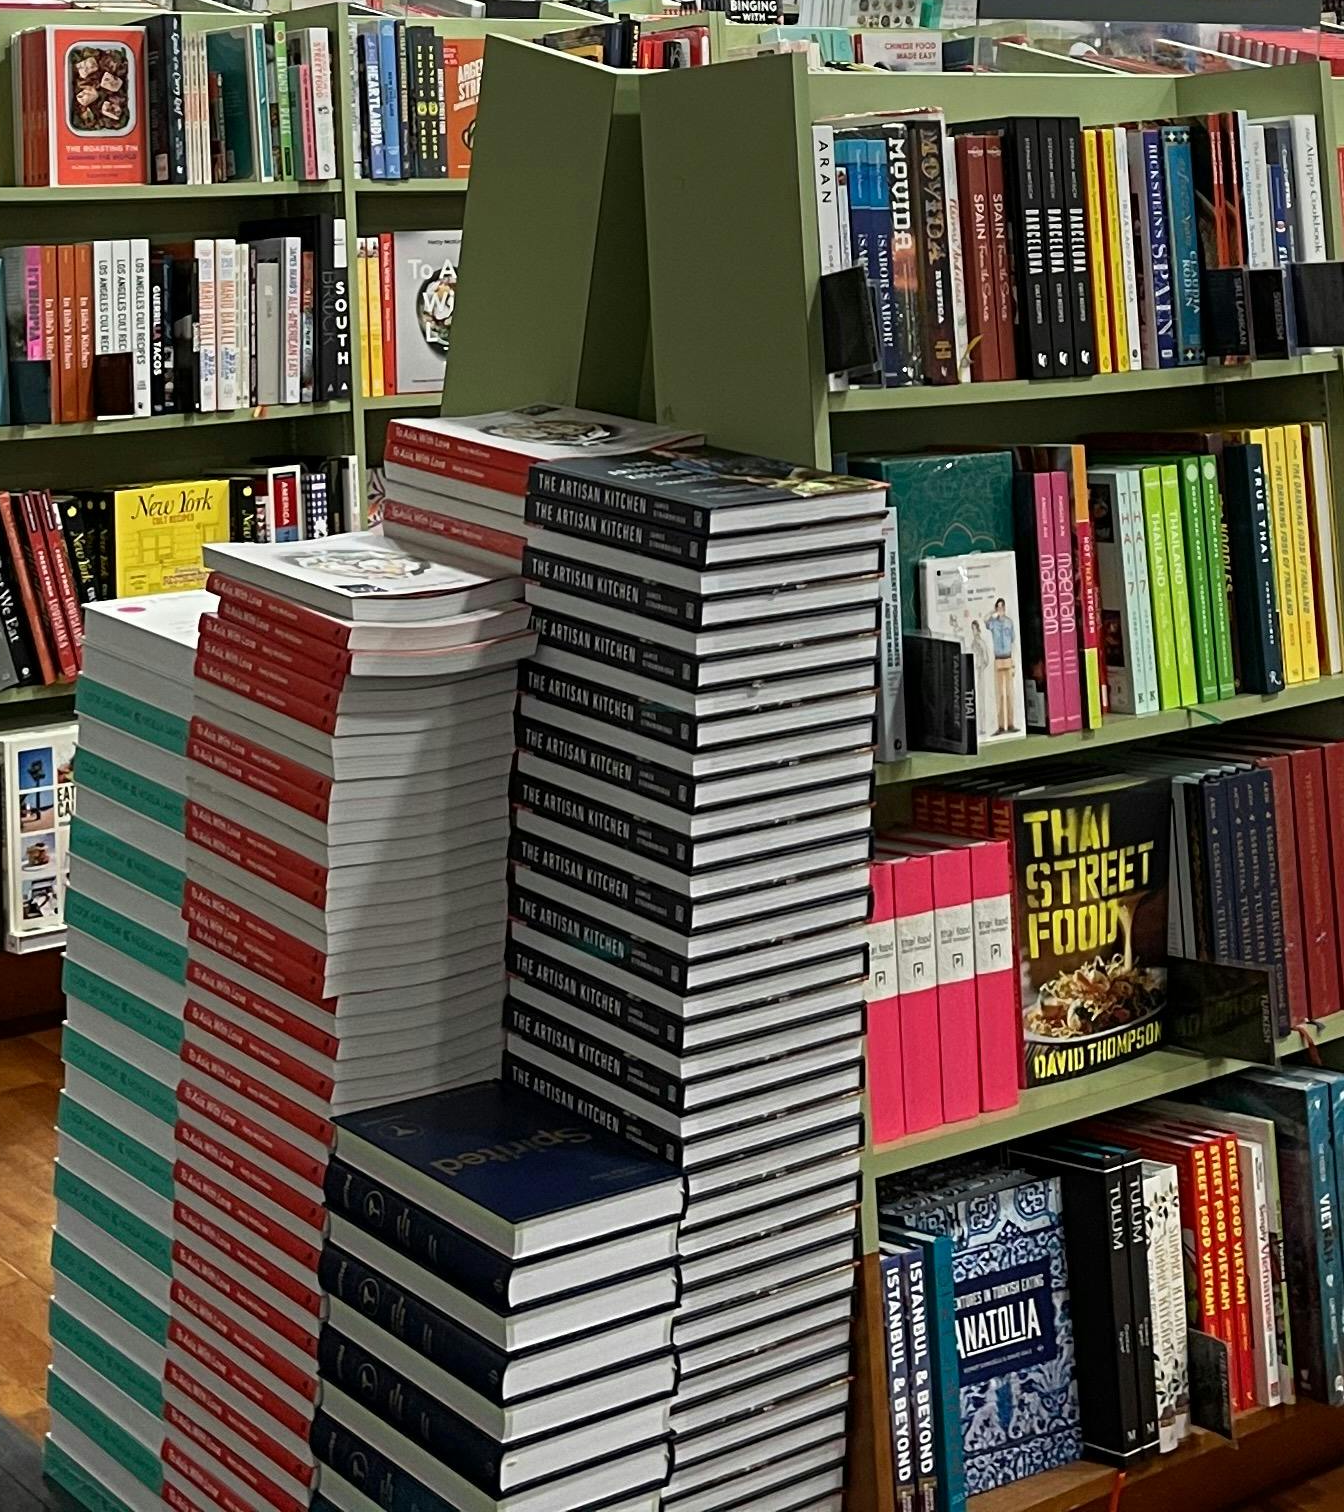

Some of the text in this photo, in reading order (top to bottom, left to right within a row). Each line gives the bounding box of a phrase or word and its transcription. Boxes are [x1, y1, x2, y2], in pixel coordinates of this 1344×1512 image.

[730, 0, 778, 12] BINGING
[743, 13, 766, 21] WITH
[884, 42, 936, 51] CHINESE FOOD
[896, 52, 937, 60] MADE EASY
[366, 66, 383, 145] HEARTLANDIA
[818, 140, 831, 204] ARAN
[973, 193, 986, 240] SPAIN
[992, 193, 1005, 240] SPAIN
[99, 260, 109, 336] LOS ANGELES CULT
[408, 259, 433, 280] To
[135, 258, 146, 365] LOS ANGELES CULT RECIPES
[334, 281, 348, 365] SOUTH
[131, 491, 214, 521] New York
[281, 482, 289, 526] AMERICA
[536, 501, 643, 544] THE ARTISAN KITCHEN
[539, 473, 556, 492] THE
[559, 477, 601, 503] ARTISAN
[604, 490, 646, 514] KITCHEN
[1253, 465, 1268, 564] TRUE THAI
[1151, 513, 1166, 587] THAILAND
[1167, 511, 1184, 585] THAILAND
[0, 589, 14, 616] We
[532, 558, 639, 603] THE ARTISAN KITCHEN
[1040, 554, 1058, 635] maenam
[1058, 552, 1075, 633] maenam
[6, 616, 19, 643] Eat
[964, 687, 975, 721] THAI
[1023, 802, 1112, 860] THAI
[1025, 841, 1155, 909] STREET
[1027, 898, 1121, 960] FOOD
[1261, 993, 1271, 1044] TURKISH
[1034, 1020, 1162, 1080] DAVID THOMPSON
[437, 1123, 594, 1177] Spirited
[1109, 1180, 1125, 1250] TULUM
[1129, 1175, 1144, 1243] TULUM
[1194, 1150, 1215, 1316] STREET FOOD VIETNAM
[1319, 1193, 1333, 1264] VIETNAM
[955, 1298, 1041, 1359] ANATOLIA
[885, 1266, 912, 1482] ISTANBUL & BEYOND
[908, 1261, 936, 1475] ISTANBUL & BEYOND
